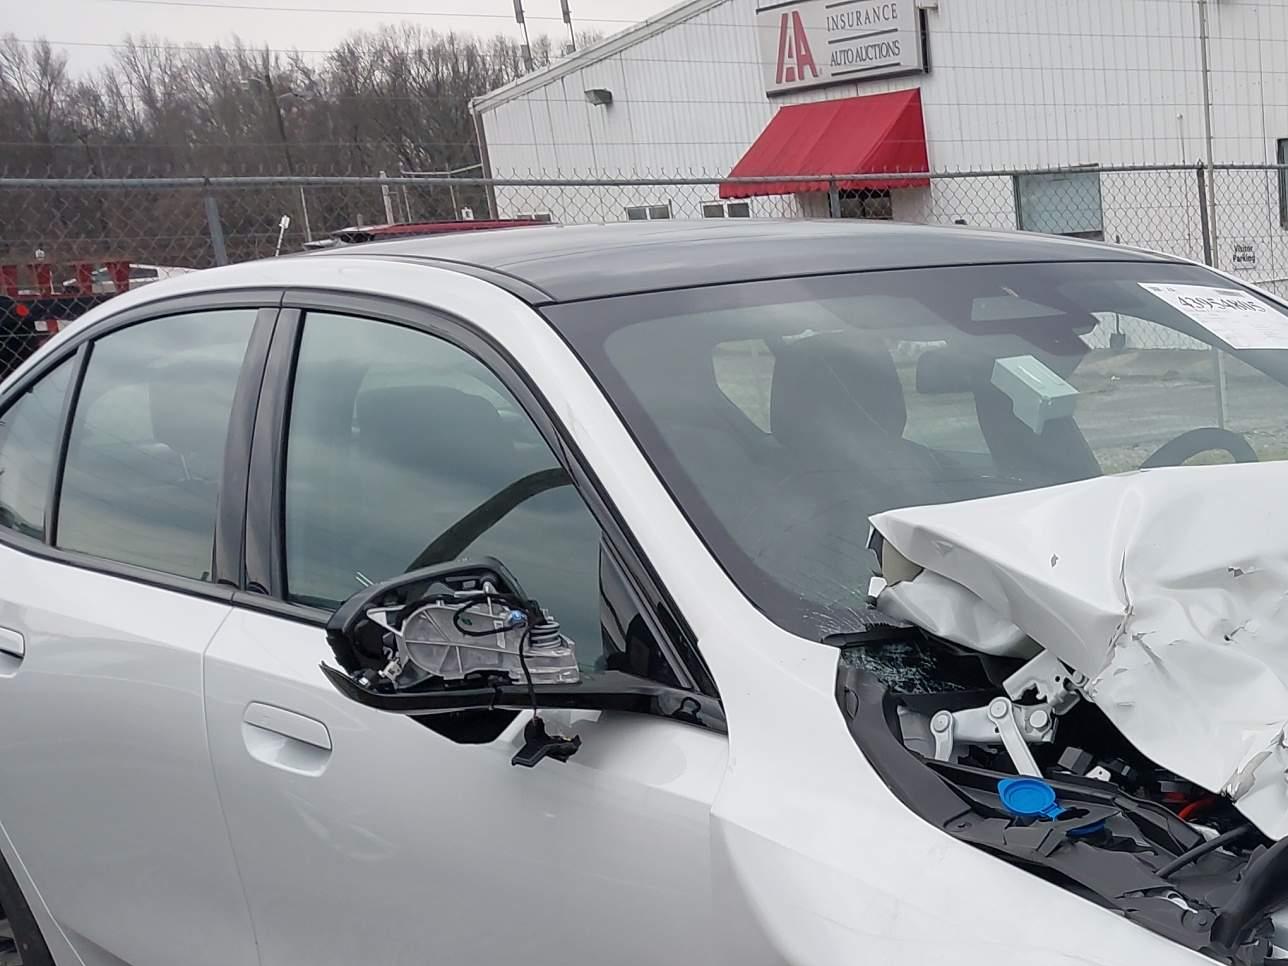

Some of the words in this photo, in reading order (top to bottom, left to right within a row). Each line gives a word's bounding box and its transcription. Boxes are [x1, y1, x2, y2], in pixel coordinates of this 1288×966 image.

[827, 4, 898, 32] INSURANCE
[830, 43, 854, 67] AUTO
[855, 39, 900, 64] AUCTIONS
[1233, 253, 1255, 263] Parking
